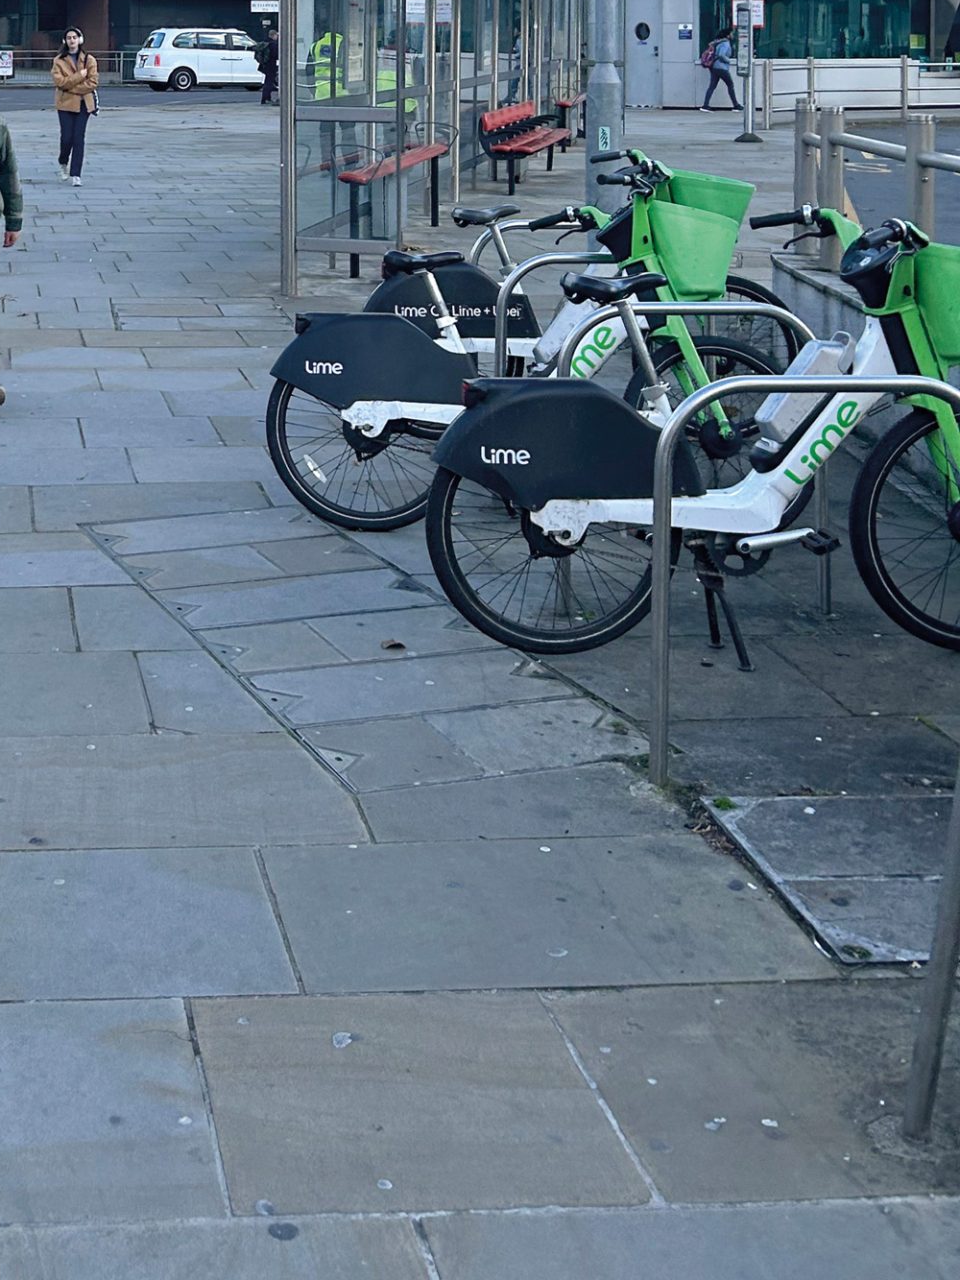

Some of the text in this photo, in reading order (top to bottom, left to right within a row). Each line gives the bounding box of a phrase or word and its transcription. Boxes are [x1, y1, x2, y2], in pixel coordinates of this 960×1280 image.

[394, 305, 428, 317] Lime
[451, 305, 481, 317] Lime
[305, 360, 344, 375] Lime
[783, 400, 861, 485] Lime
[481, 446, 531, 465] Lime
